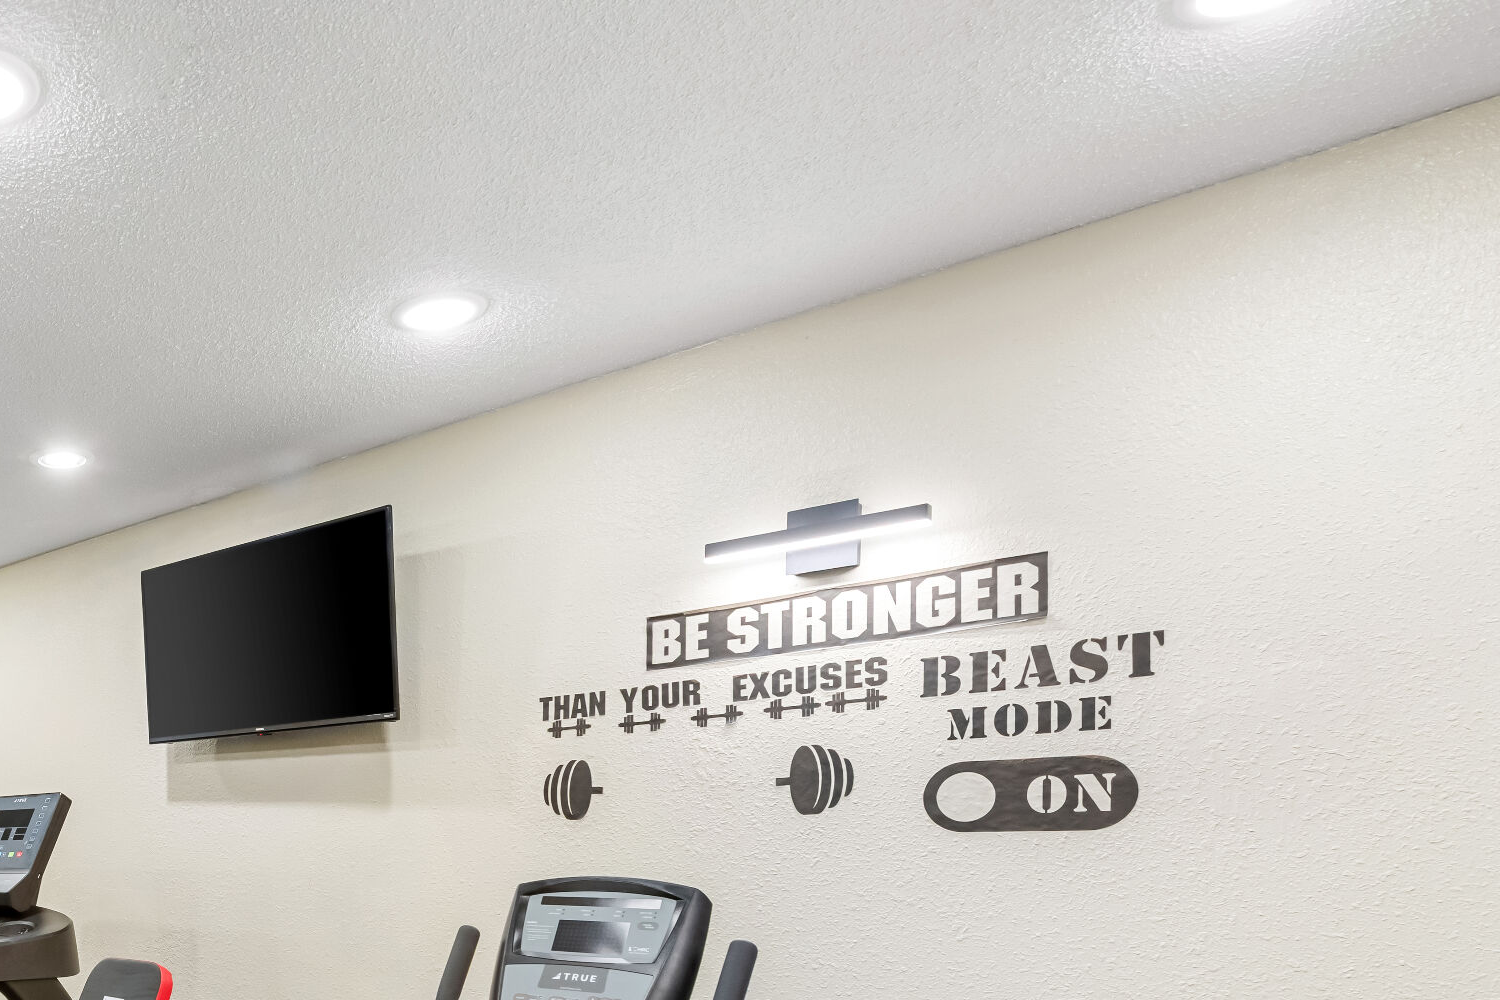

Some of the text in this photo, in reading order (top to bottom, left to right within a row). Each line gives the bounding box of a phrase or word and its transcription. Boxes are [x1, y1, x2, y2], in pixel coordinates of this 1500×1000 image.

[652, 562, 1039, 665] BE STRONGER
[539, 656, 888, 721] THAN YOUR EXCUSES
[920, 630, 1165, 698] BEAST
[947, 696, 1112, 740] MODE
[1026, 773, 1116, 814] ON
[563, 972, 598, 983] TRUE
